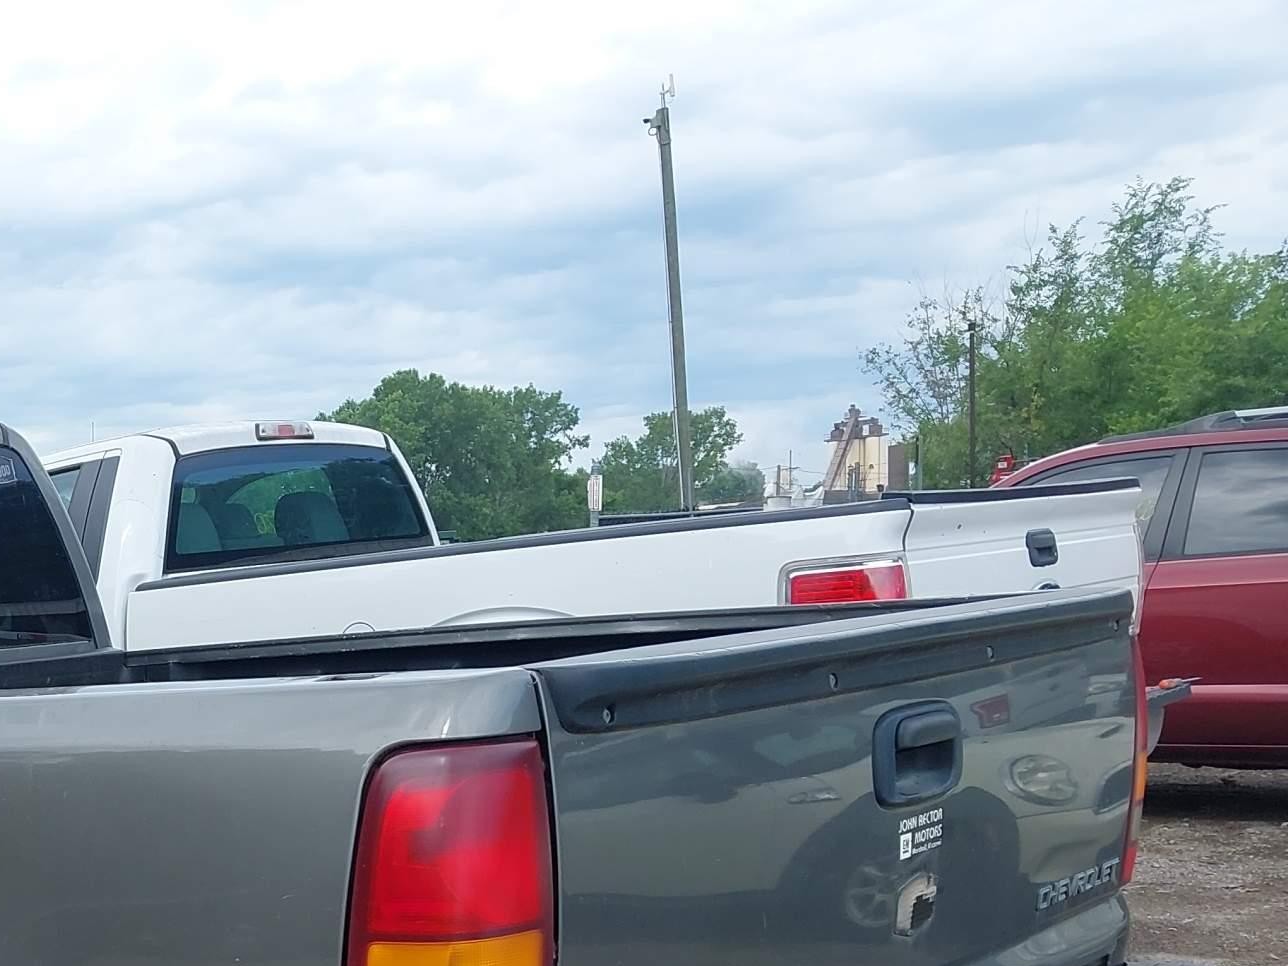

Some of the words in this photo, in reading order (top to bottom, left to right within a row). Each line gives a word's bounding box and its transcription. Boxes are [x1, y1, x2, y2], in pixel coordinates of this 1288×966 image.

[898, 816, 917, 834] JOHN
[915, 824, 942, 844] MOTORS
[1037, 857, 1120, 910] CHEVROLET
